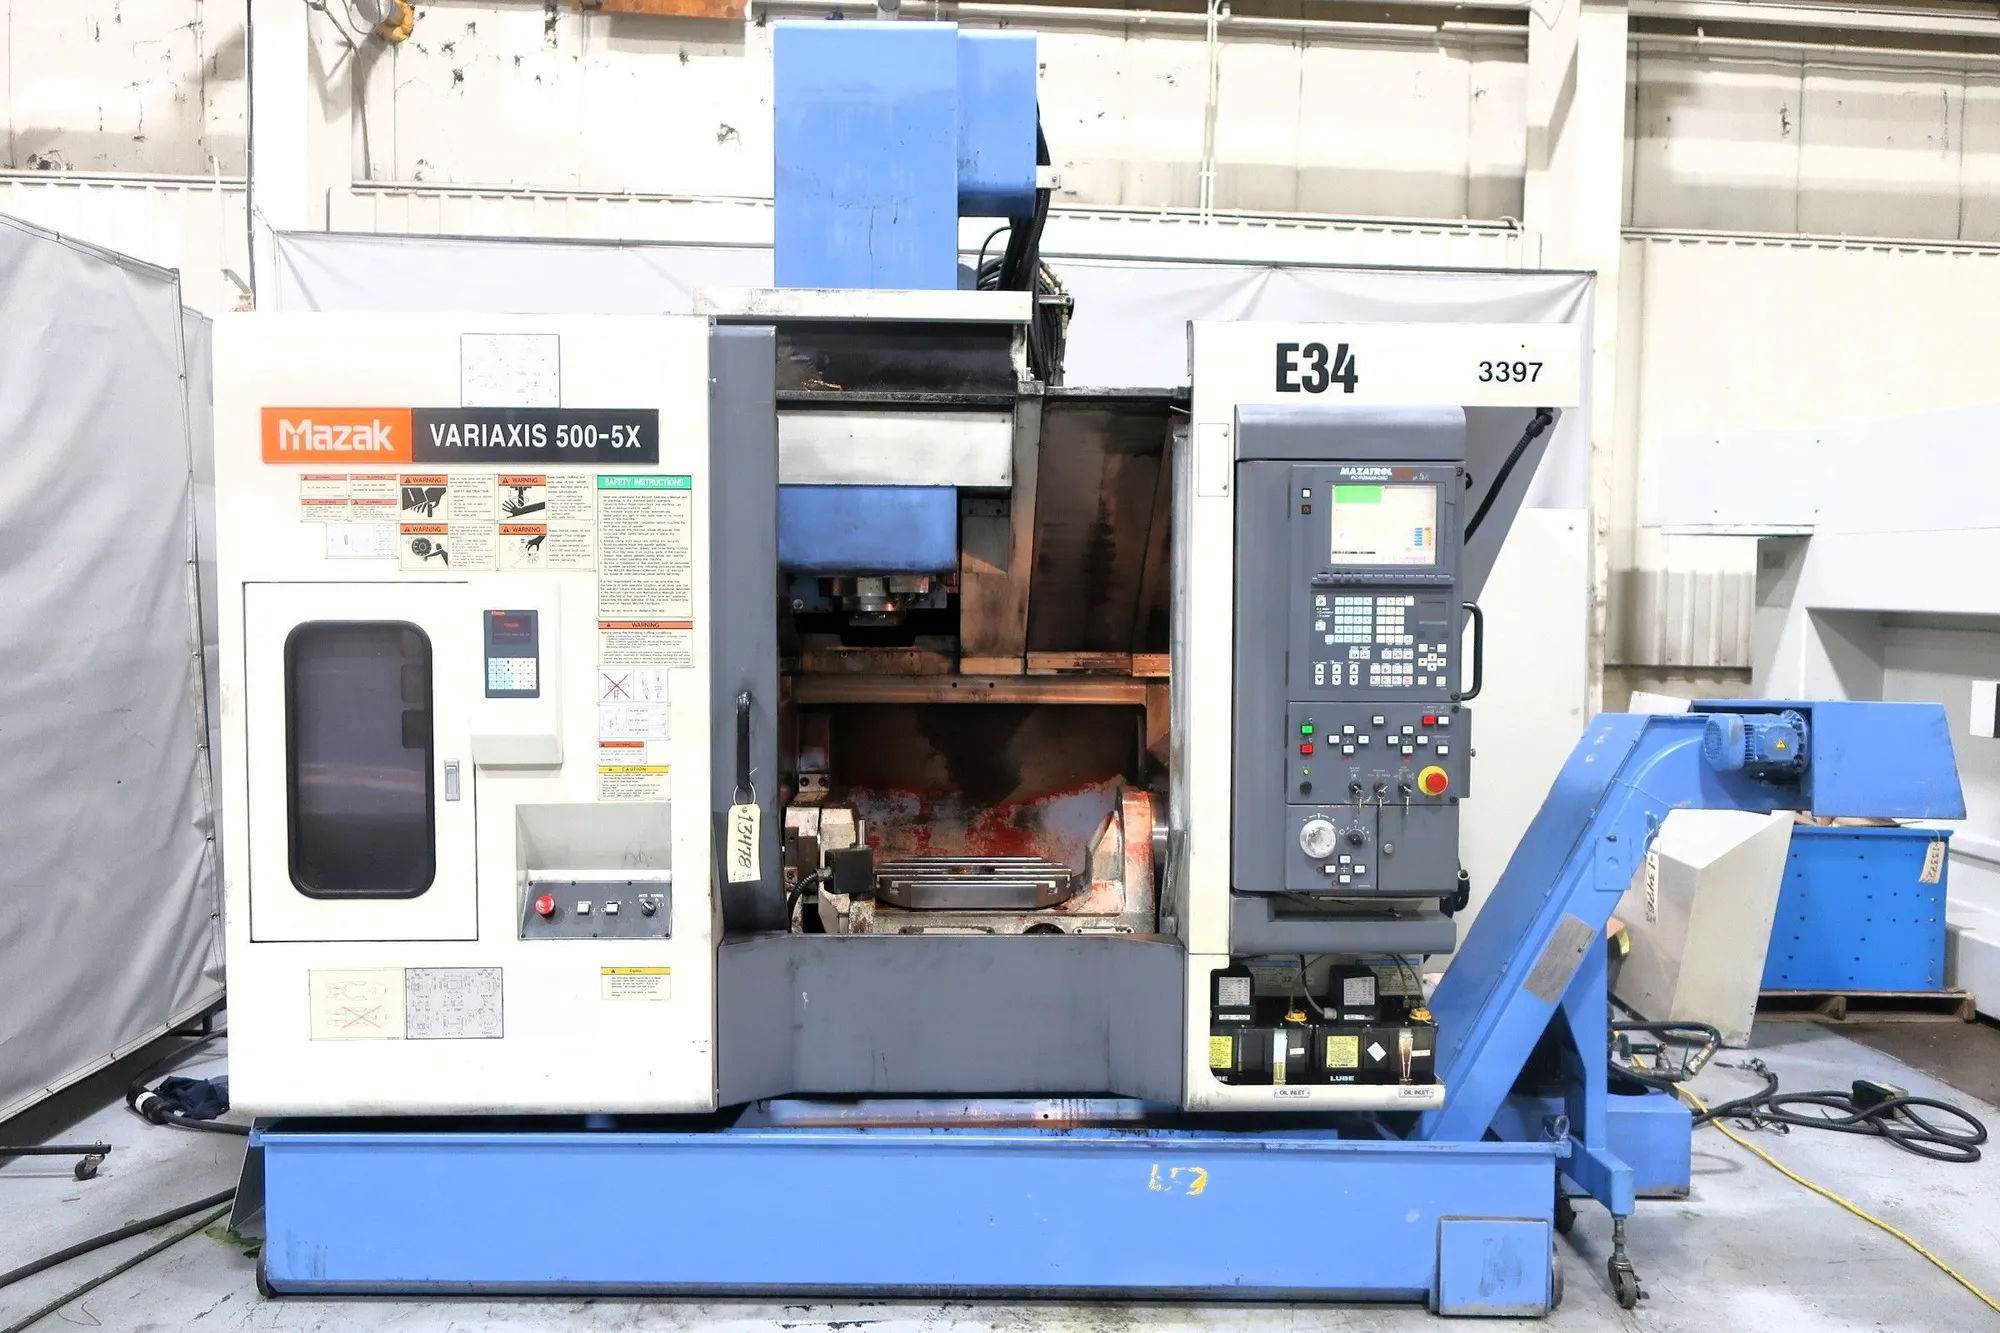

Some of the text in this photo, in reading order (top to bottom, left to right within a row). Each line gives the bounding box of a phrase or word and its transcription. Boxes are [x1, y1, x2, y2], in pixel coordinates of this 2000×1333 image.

[1275, 342, 1358, 394] E34
[1478, 361, 1543, 383] 3397
[278, 418, 394, 452] Mazak
[430, 423, 642, 448] VARIAXIS 500-5X
[604, 477, 631, 486] SAFETY
[1340, 467, 1392, 476] MAZATROL
[737, 815, 754, 869] 13478
